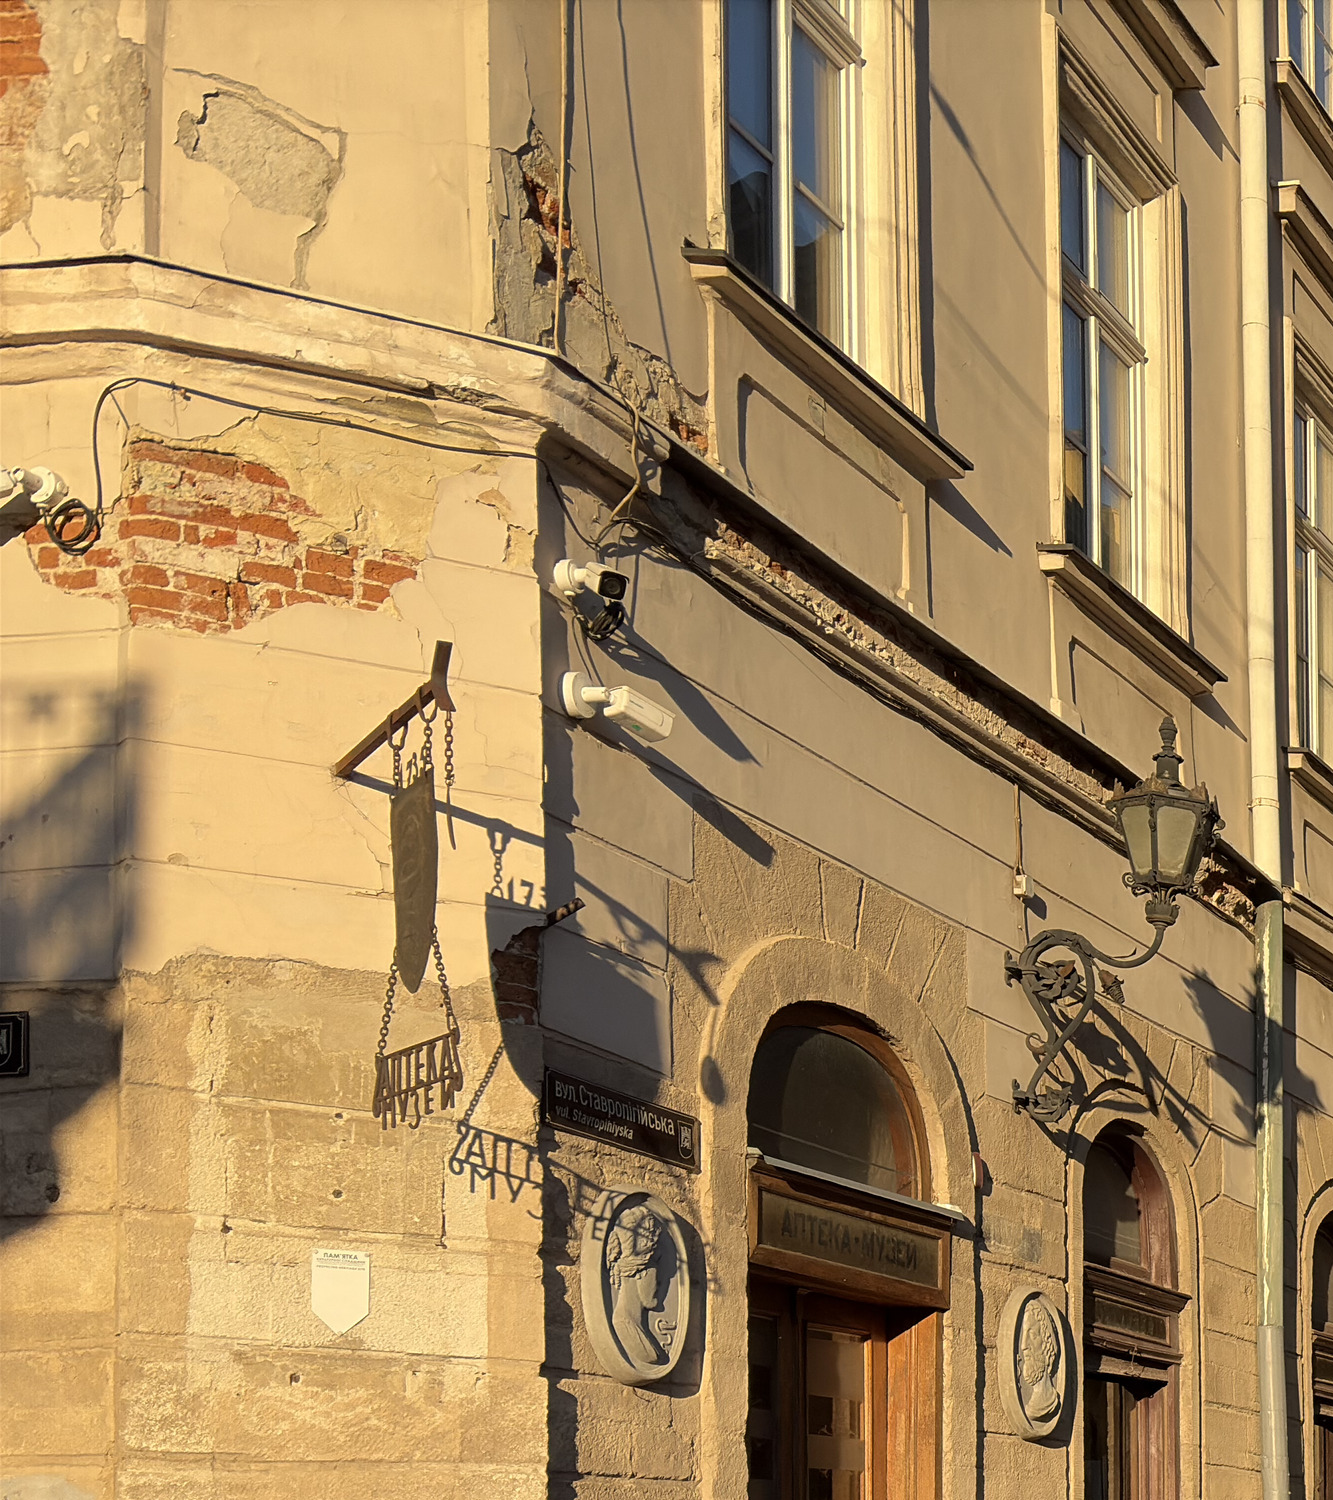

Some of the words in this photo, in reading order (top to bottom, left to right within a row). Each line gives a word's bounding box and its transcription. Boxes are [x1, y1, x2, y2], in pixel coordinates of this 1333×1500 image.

[555, 1104, 571, 1120] vul.
[572, 1108, 634, 1141] Stavropihiyska
[579, 1084, 676, 1136] Ставропігійська
